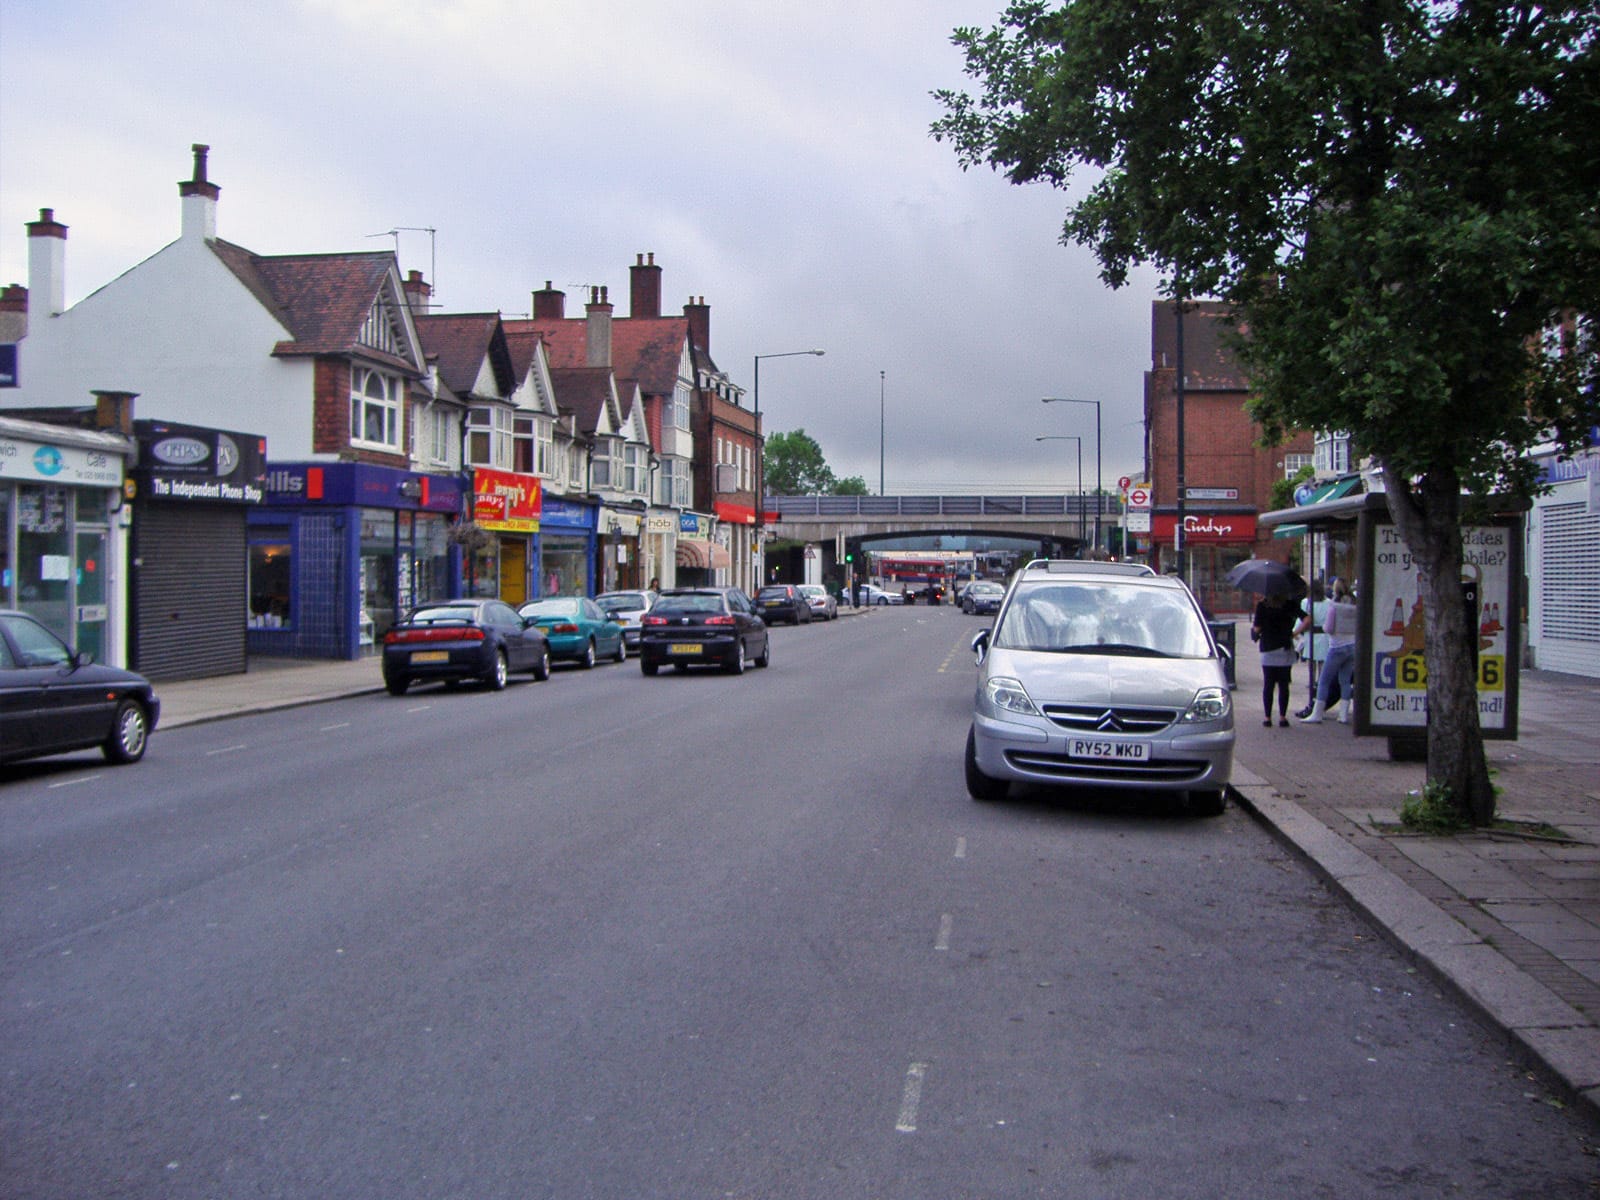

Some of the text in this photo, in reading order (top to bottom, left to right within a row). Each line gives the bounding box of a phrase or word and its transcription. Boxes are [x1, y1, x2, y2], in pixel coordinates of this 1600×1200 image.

[154, 478, 262, 503] The Independent Phone Shop
[1183, 515, 1232, 536] Cindys
[1462, 530, 1503, 545] dates
[1377, 553, 1397, 564] on
[1374, 695, 1405, 711] Call
[1480, 698, 1503, 713] nd!
[1075, 741, 1143, 757] RY52 WKD
